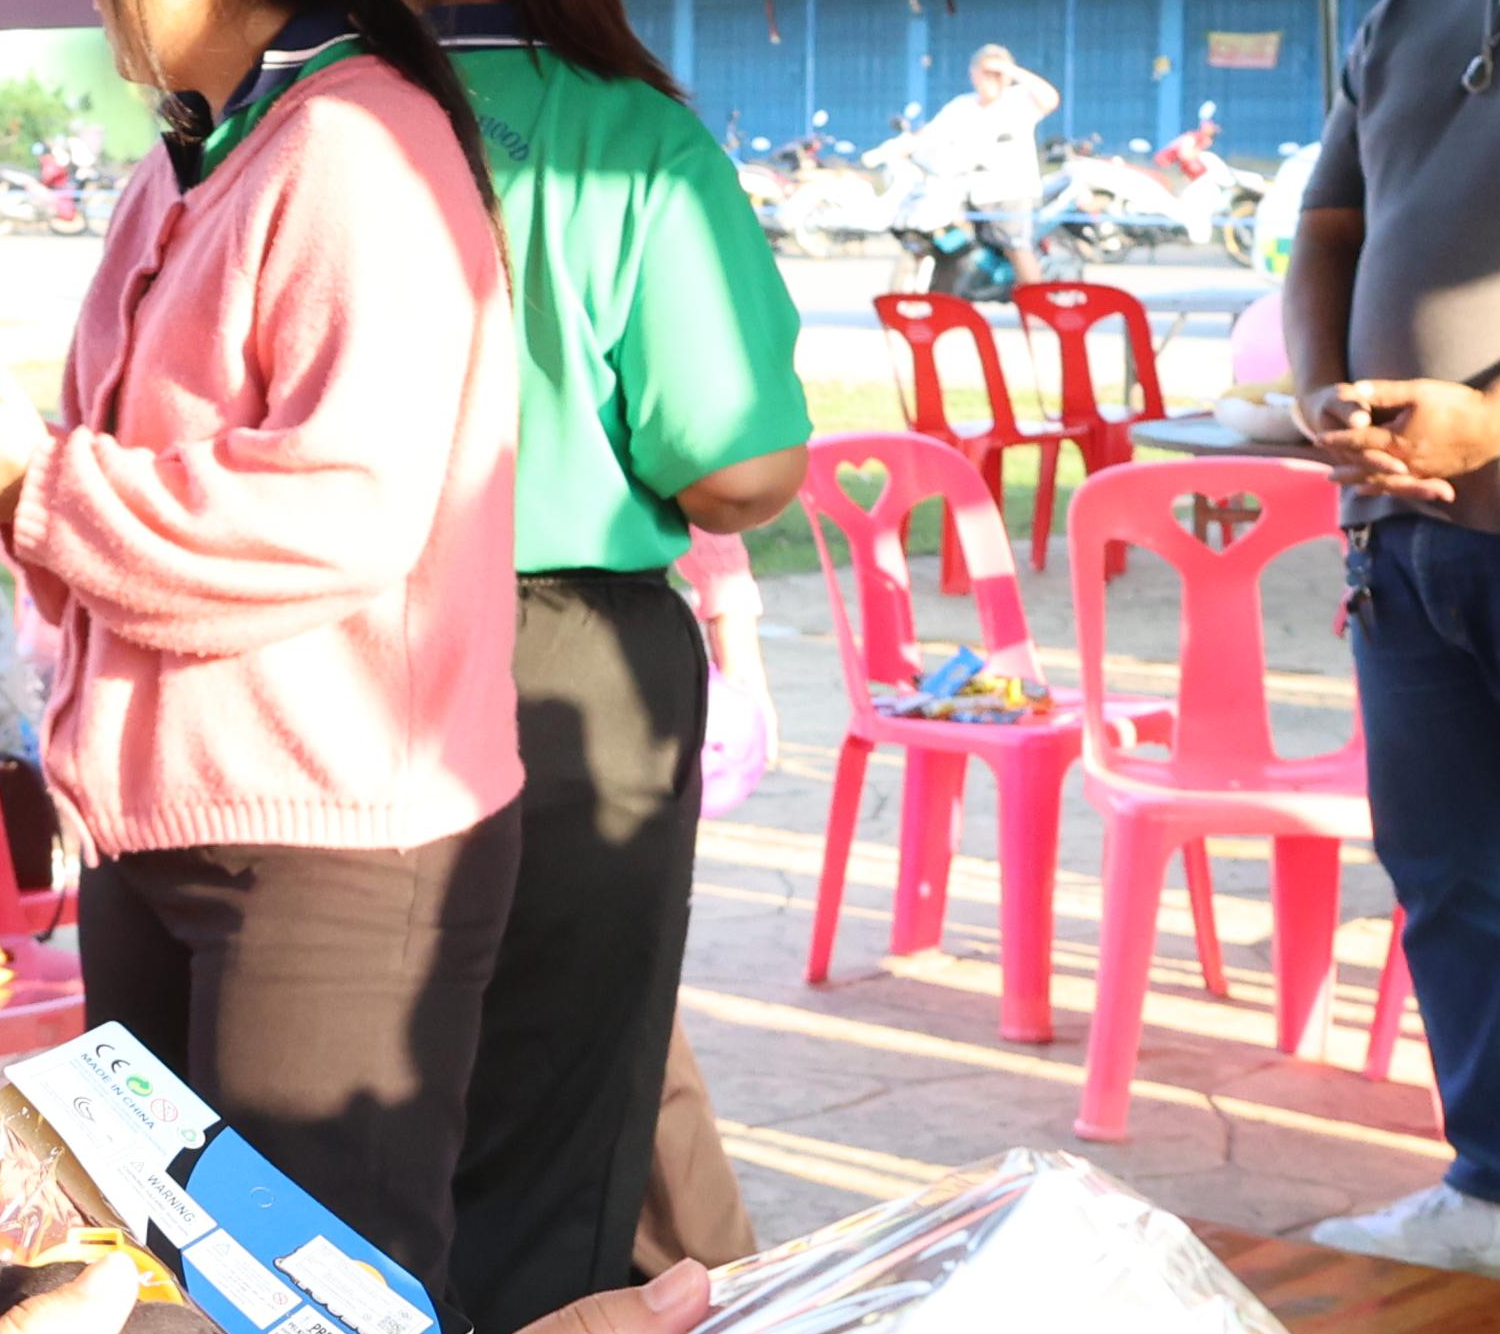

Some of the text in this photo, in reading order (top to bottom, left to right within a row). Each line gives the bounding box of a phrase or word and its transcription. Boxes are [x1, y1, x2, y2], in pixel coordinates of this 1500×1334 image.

[80, 1053, 113, 1084] MADE
[110, 1083, 124, 1097] IN
[122, 1095, 156, 1130] CHINA
